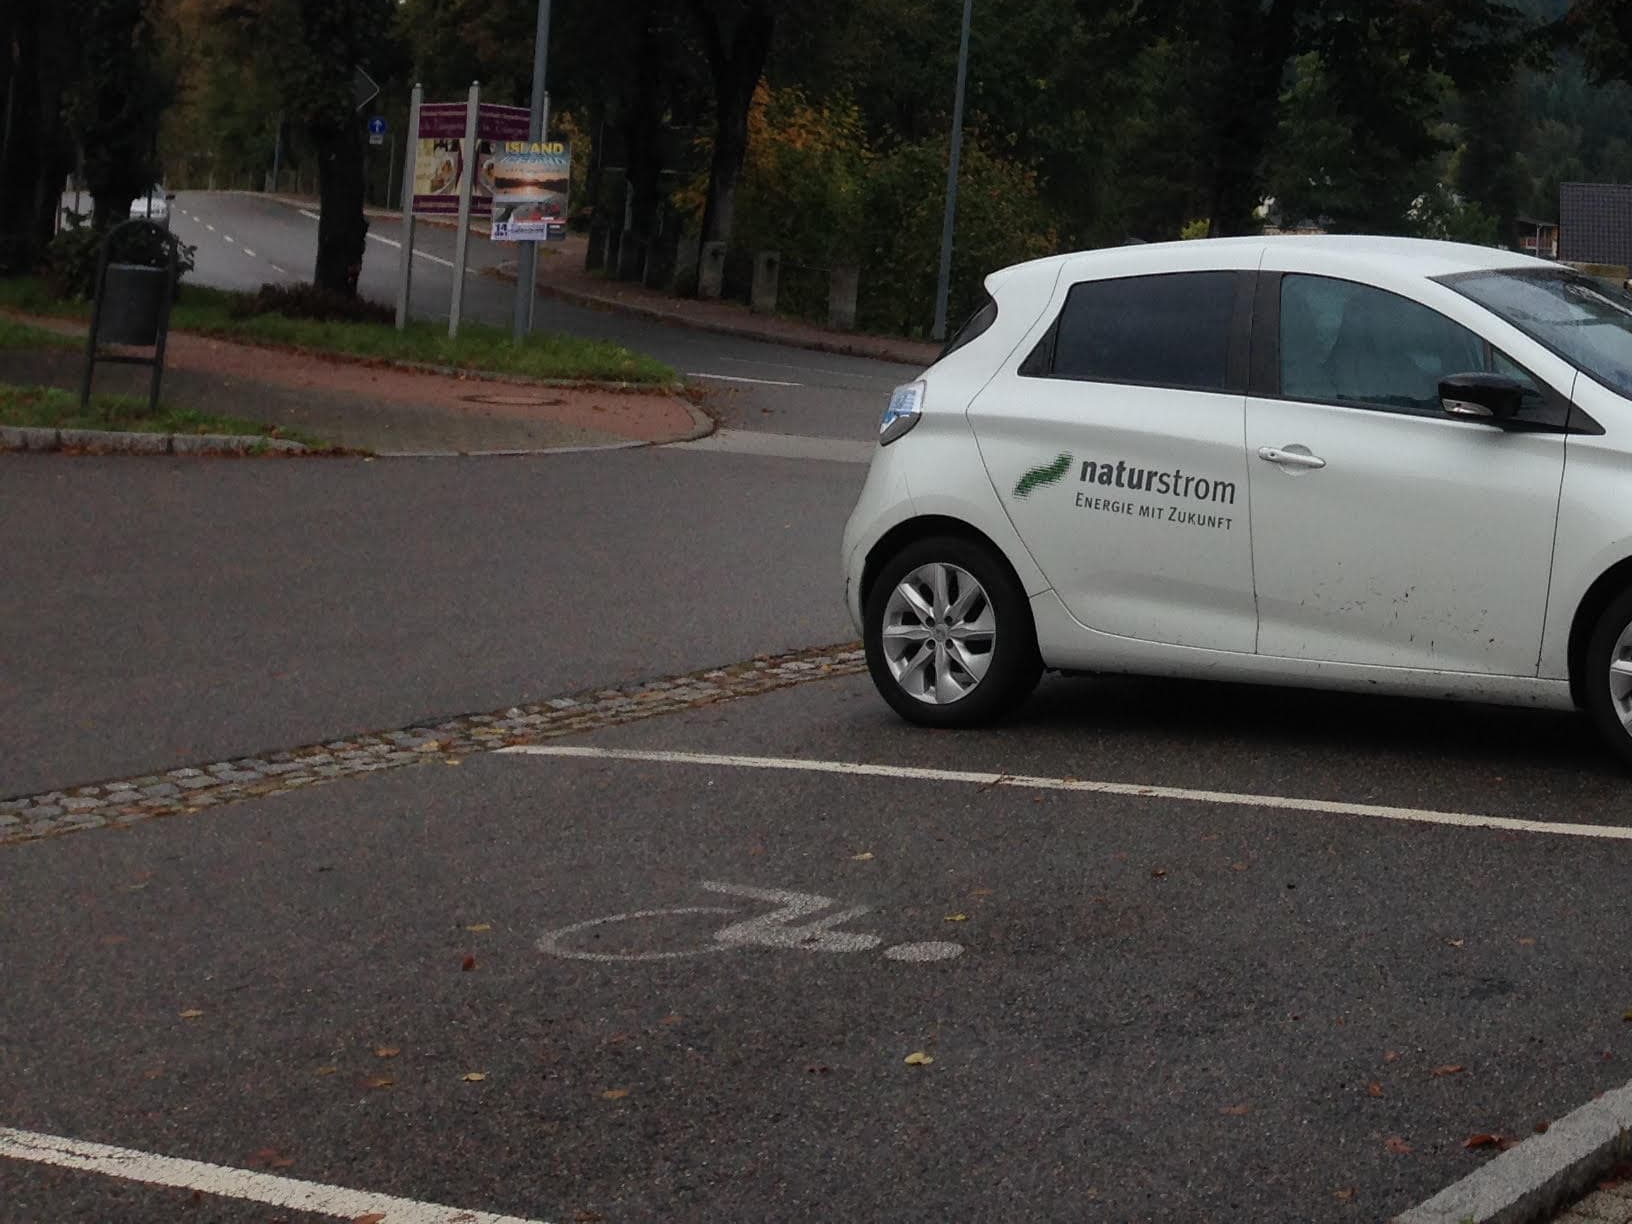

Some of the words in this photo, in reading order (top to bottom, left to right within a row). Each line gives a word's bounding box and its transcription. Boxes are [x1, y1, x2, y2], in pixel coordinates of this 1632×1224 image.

[506, 142, 564, 153] ISLAND
[1079, 460, 1236, 504] naturstrom
[1075, 492, 1134, 515] ENERGIE
[1138, 505, 1164, 520] MIT
[1168, 507, 1233, 530] ZUKUNFT
